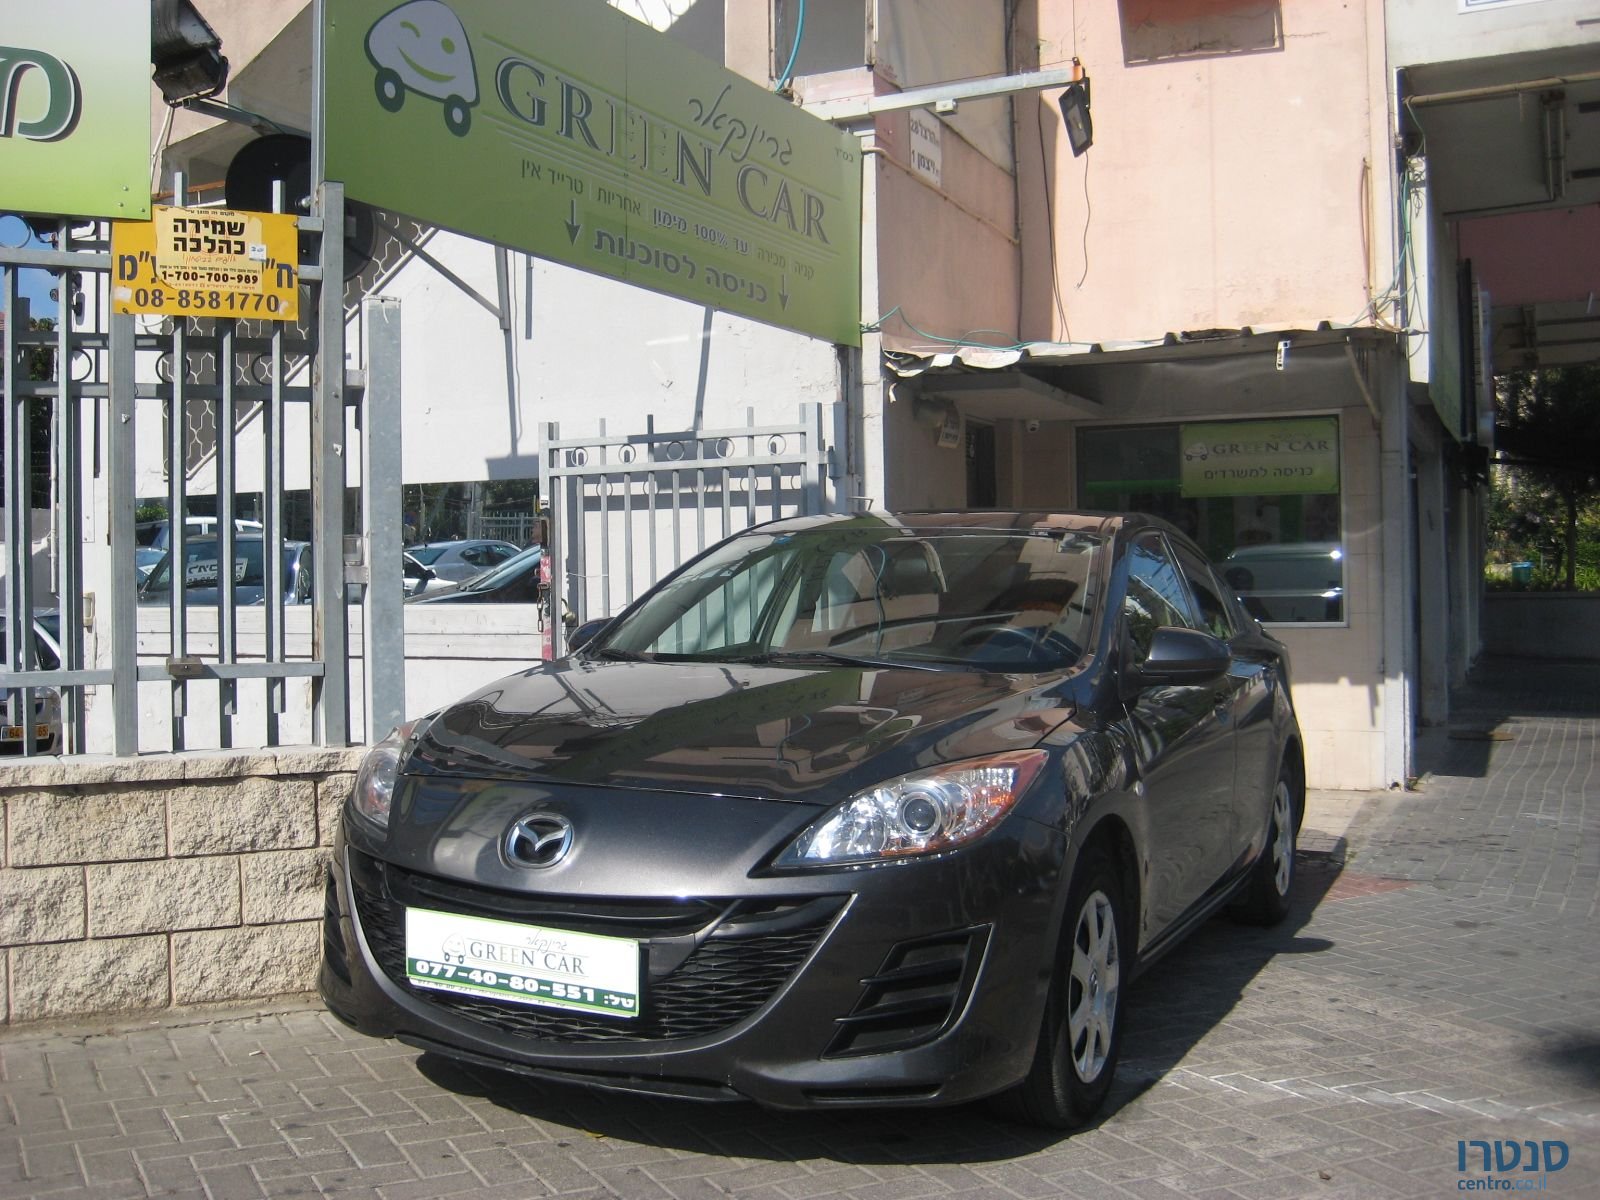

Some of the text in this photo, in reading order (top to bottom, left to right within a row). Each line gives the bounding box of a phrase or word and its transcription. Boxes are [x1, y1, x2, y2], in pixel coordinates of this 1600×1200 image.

[688, 84, 793, 166] גרינקאר
[494, 56, 831, 246] GREEN CAR
[521, 159, 541, 180] אין
[547, 167, 584, 195] טרייד
[597, 186, 641, 217] אחריות
[173, 217, 245, 237] שמירה
[652, 207, 688, 233] מימון
[173, 235, 246, 255] כהלכה
[694, 223, 729, 248] 100%
[161, 270, 259, 285] 1-700-700-989
[594, 229, 768, 304] כניסה לסוכנות
[135, 288, 279, 313] 08-8581770
[1212, 440, 1330, 455] GREEN CAR
[1204, 466, 1313, 480] כניסה למשרדים
[469, 941, 585, 975] GREEN CAR
[415, 960, 595, 1003] 077-40-80-551
[603, 993, 635, 1009] טל:
